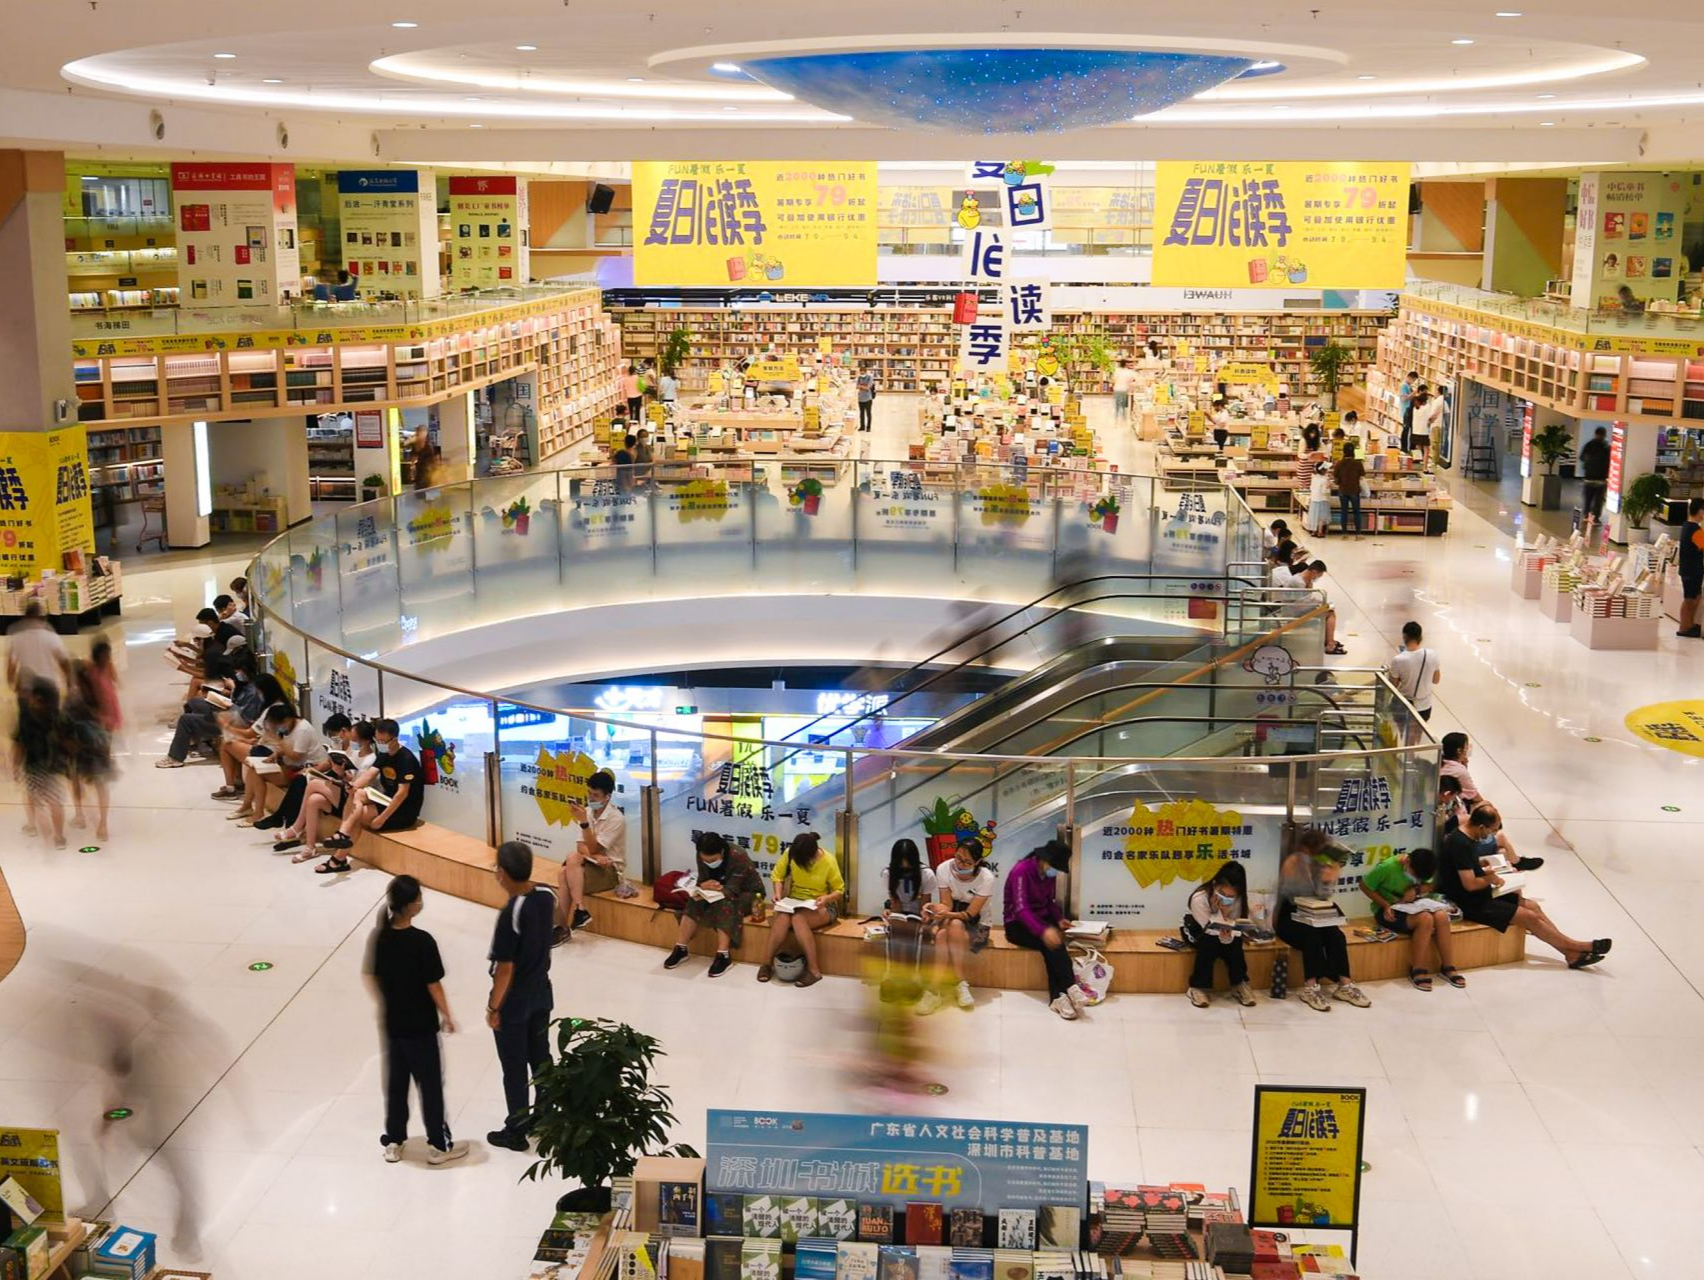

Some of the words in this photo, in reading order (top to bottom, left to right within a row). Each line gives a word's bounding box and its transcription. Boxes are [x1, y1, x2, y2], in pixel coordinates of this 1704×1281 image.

[95, 320, 130, 330] 书海梯田
[686, 795, 754, 819] FUN暑假
[760, 805, 812, 827] 乐一夏
[1102, 820, 1254, 837] 近2000种热门好书暑期特惠
[1375, 810, 1425, 833] 乐一夏
[870, 1122, 1080, 1144] 广东省人文社会科学普及基地
[967, 1143, 1080, 1161] 深圳市科普基地
